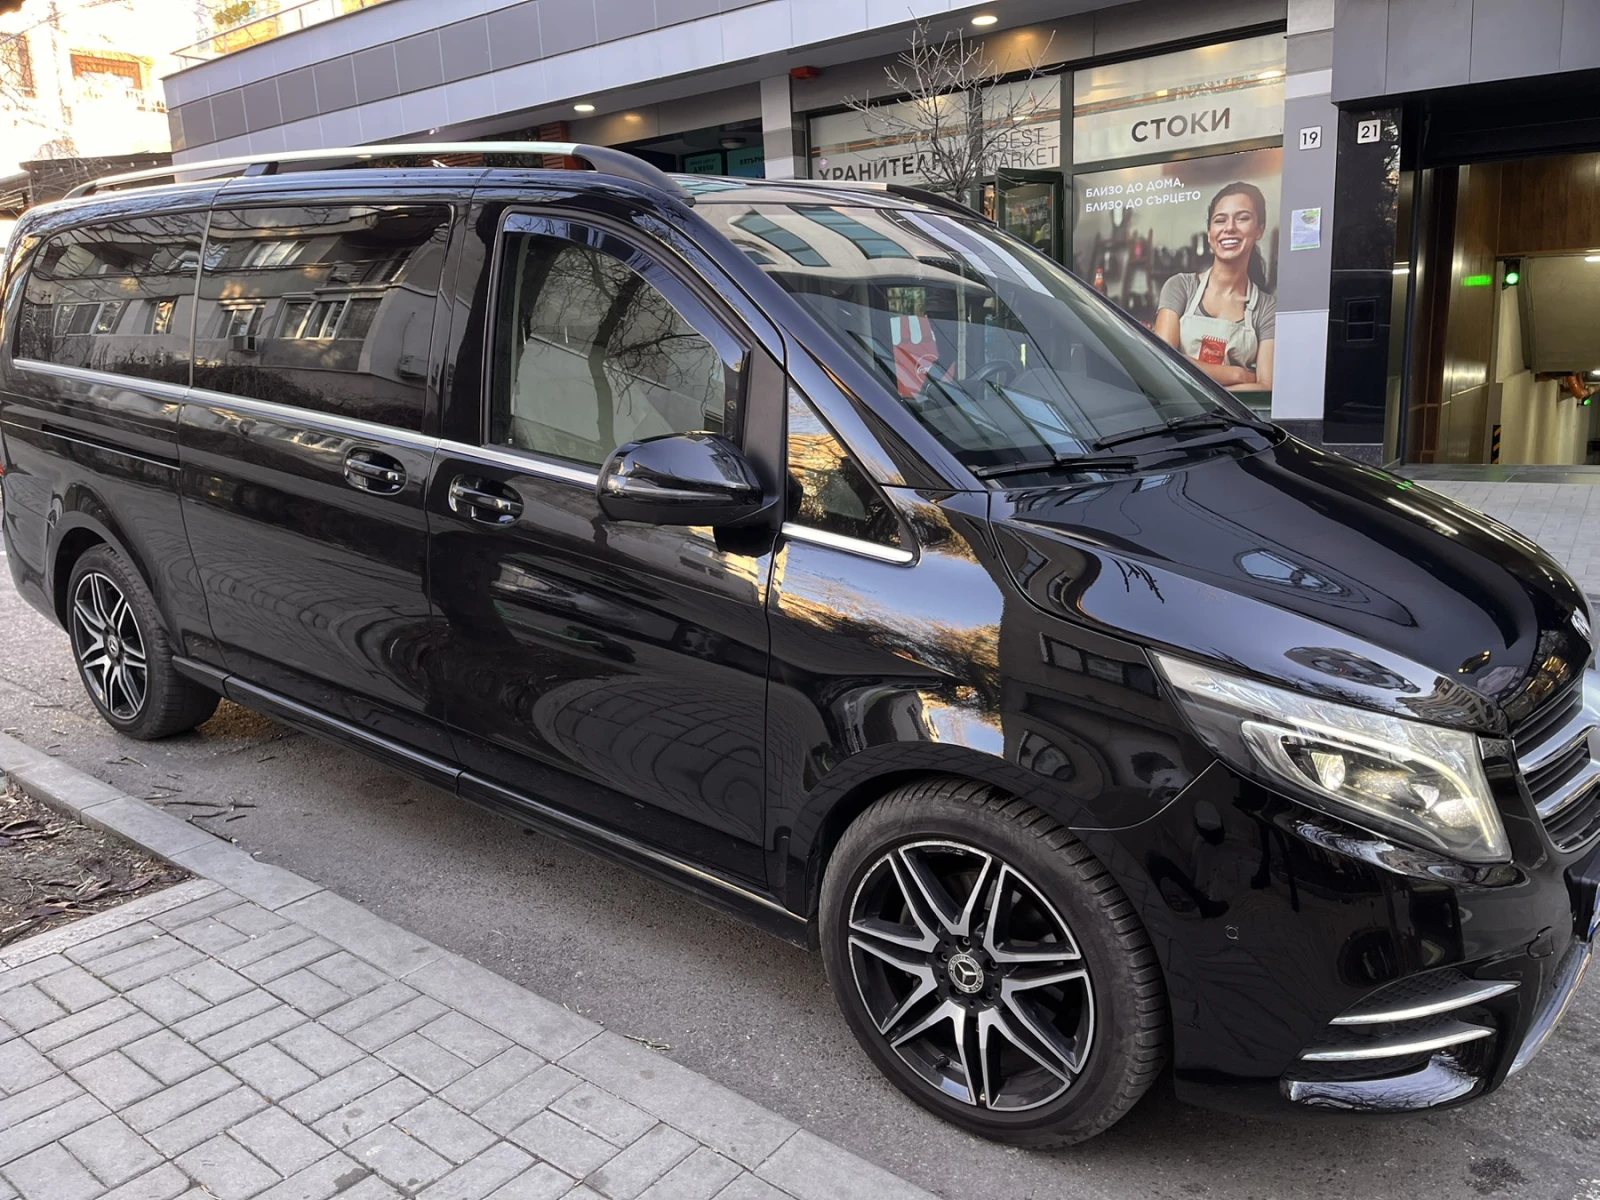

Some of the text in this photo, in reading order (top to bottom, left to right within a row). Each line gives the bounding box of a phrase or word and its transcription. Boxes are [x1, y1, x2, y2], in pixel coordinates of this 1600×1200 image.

[1131, 107, 1231, 143] СТОКИ
[1361, 124, 1378, 139] 21
[997, 126, 1045, 151] BEST
[1302, 131, 1318, 145] 19
[982, 145, 1059, 174] MARKET
[1085, 177, 1185, 198] БЛИЗО ДО ДОМА,
[1085, 190, 1201, 213] БЛИЗО ДО СЪРЦЕТО
